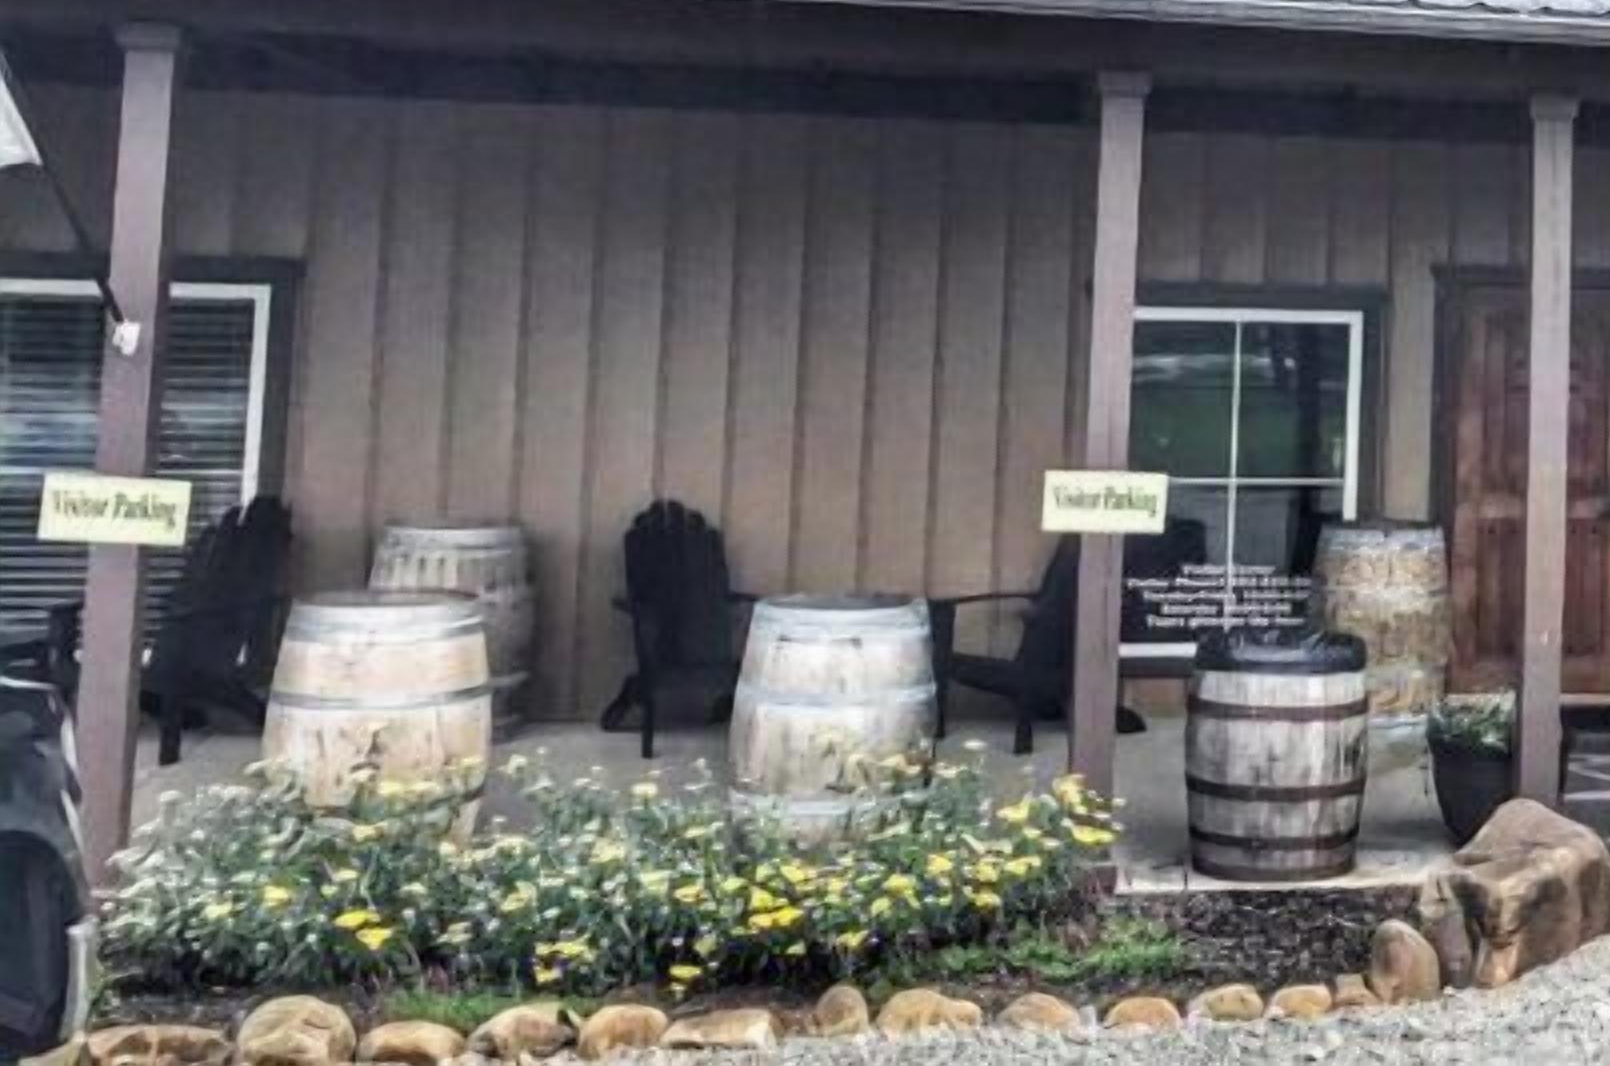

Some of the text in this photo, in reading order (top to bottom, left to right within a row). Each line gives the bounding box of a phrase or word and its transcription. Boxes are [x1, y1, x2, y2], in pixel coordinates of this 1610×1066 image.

[112, 491, 177, 528] Parking
[1053, 486, 1158, 518] Visitor Parking
